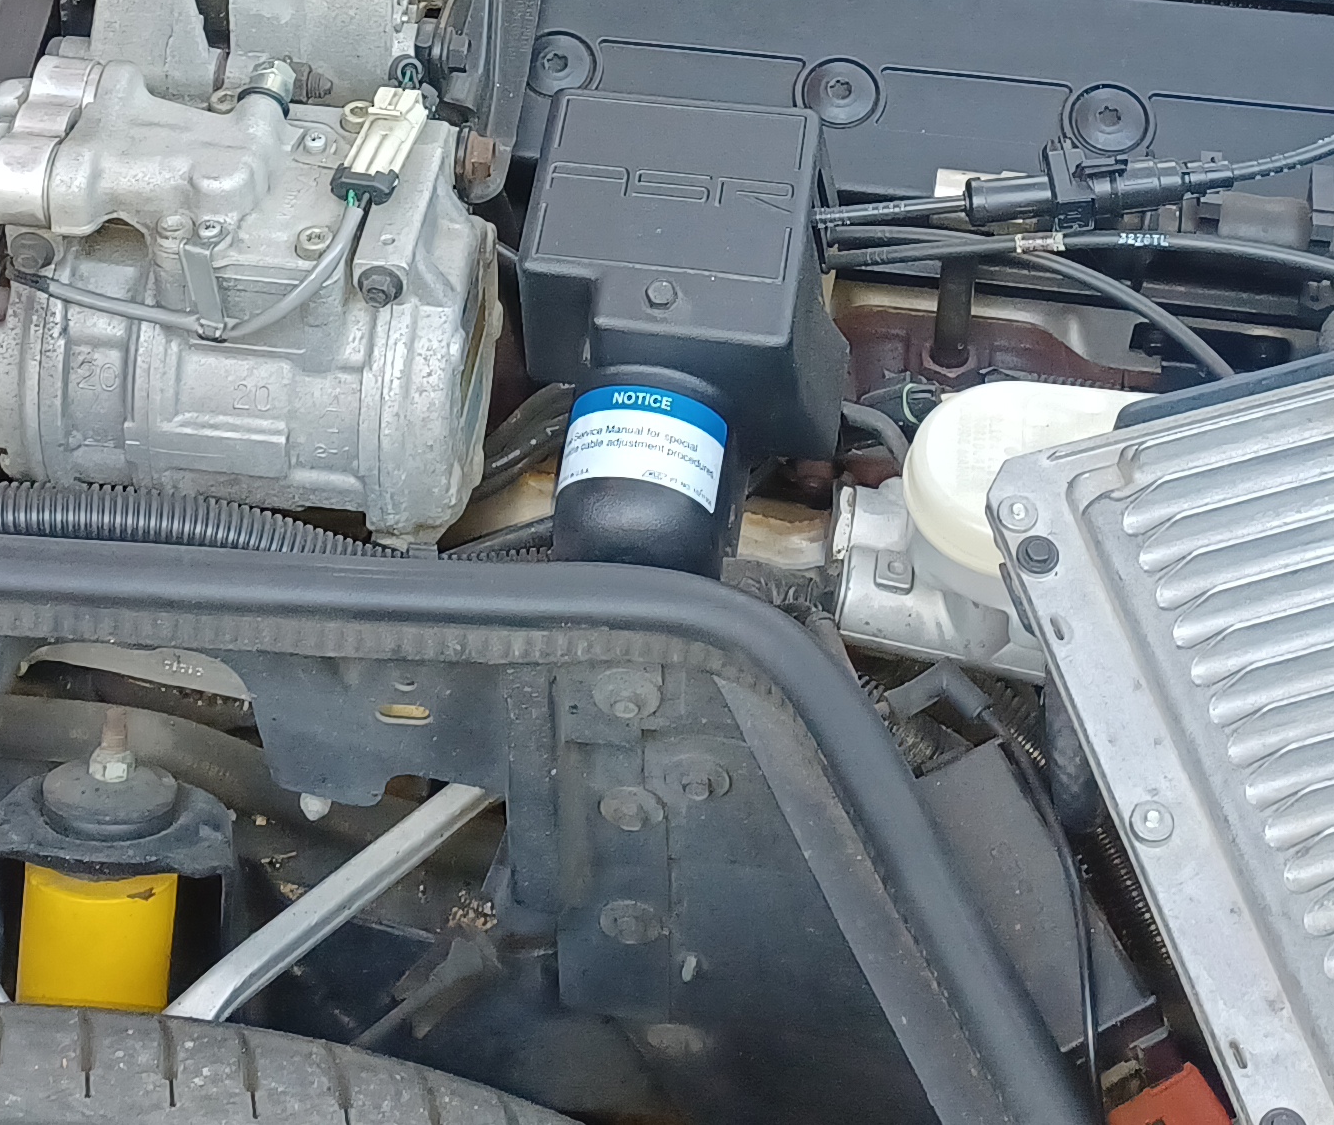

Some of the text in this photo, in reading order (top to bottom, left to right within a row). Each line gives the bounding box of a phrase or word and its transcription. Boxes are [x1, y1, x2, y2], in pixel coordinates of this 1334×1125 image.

[549, 161, 795, 212] ASR
[76, 361, 119, 391] 20
[231, 382, 271, 411] 20
[613, 391, 672, 411] NOTICE
[605, 424, 643, 436] Manual
[646, 427, 660, 437] for
[664, 433, 698, 452] special
[606, 438, 663, 452] adjustment
